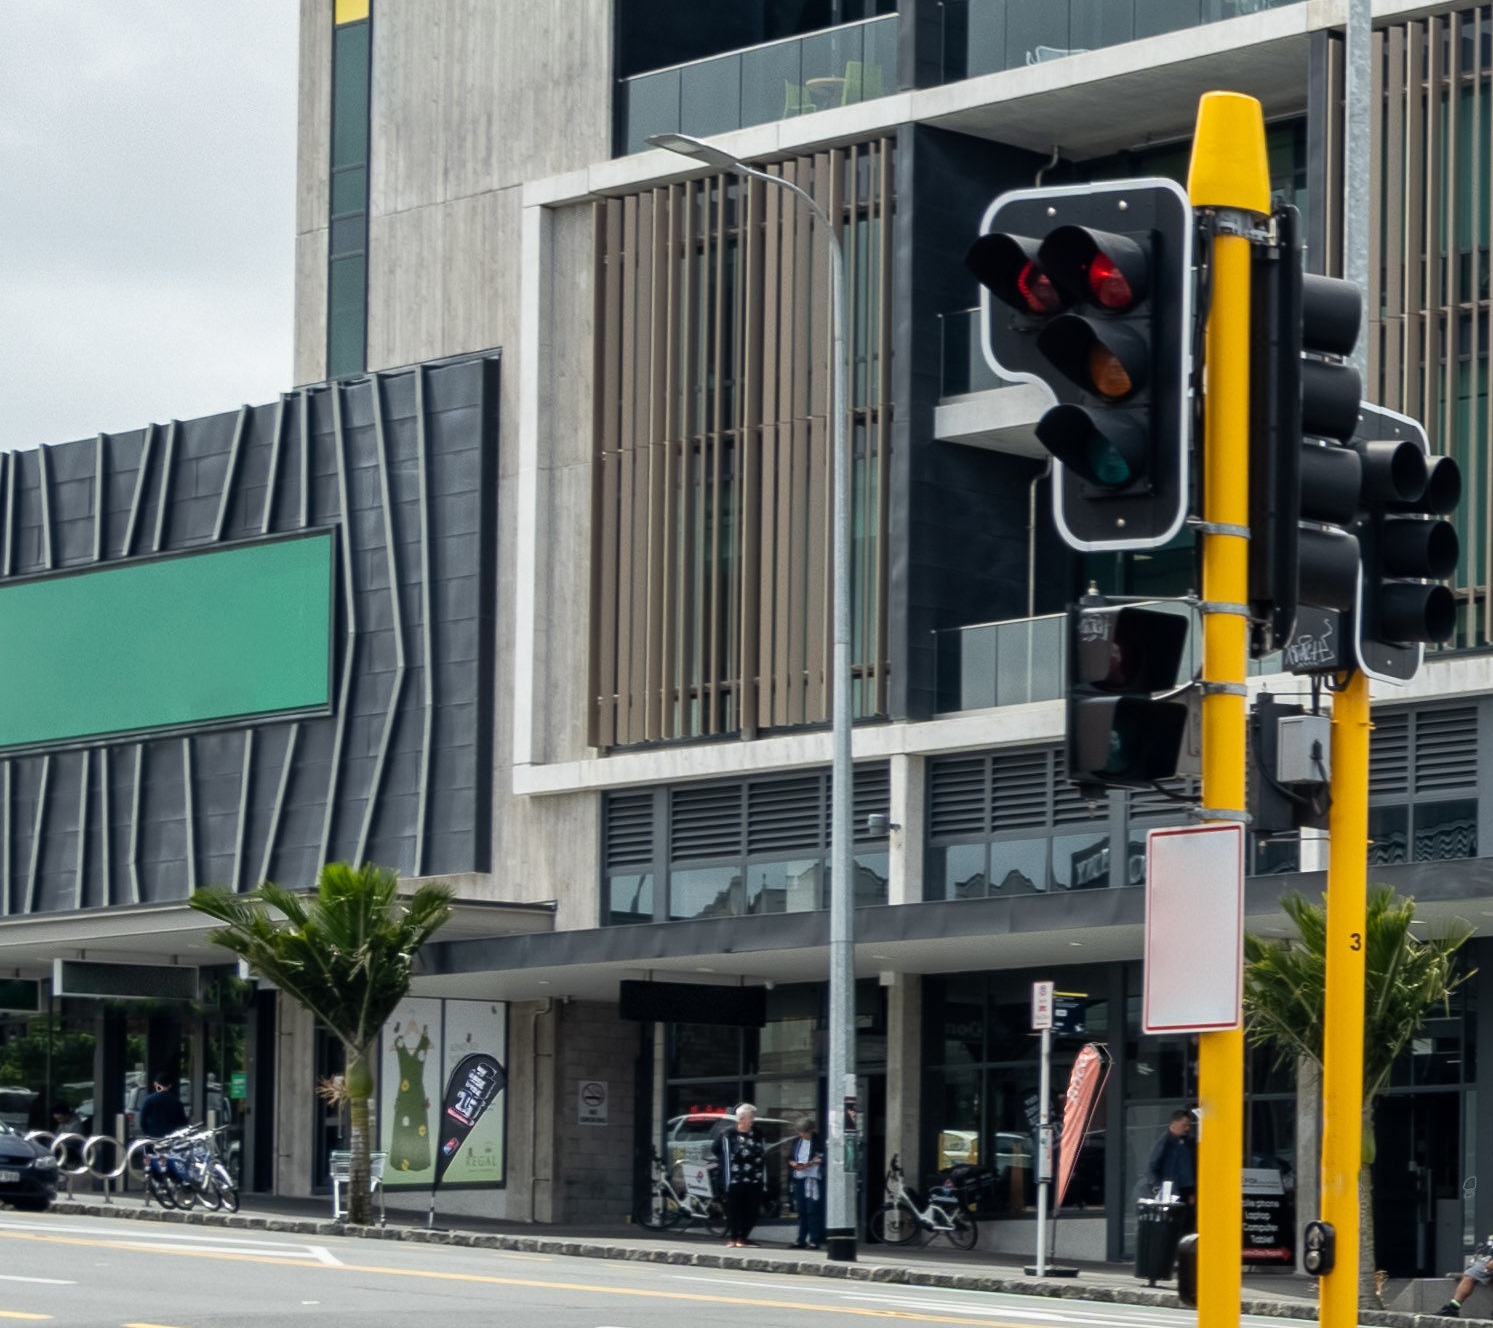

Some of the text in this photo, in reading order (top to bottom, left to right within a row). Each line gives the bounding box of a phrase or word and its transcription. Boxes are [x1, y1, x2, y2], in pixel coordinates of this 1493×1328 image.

[1350, 932, 1362, 952] 3
[1244, 1211, 1271, 1220] Laptop
[1242, 1222, 1279, 1233] Computer
[1250, 1234, 1276, 1244] Tablet
